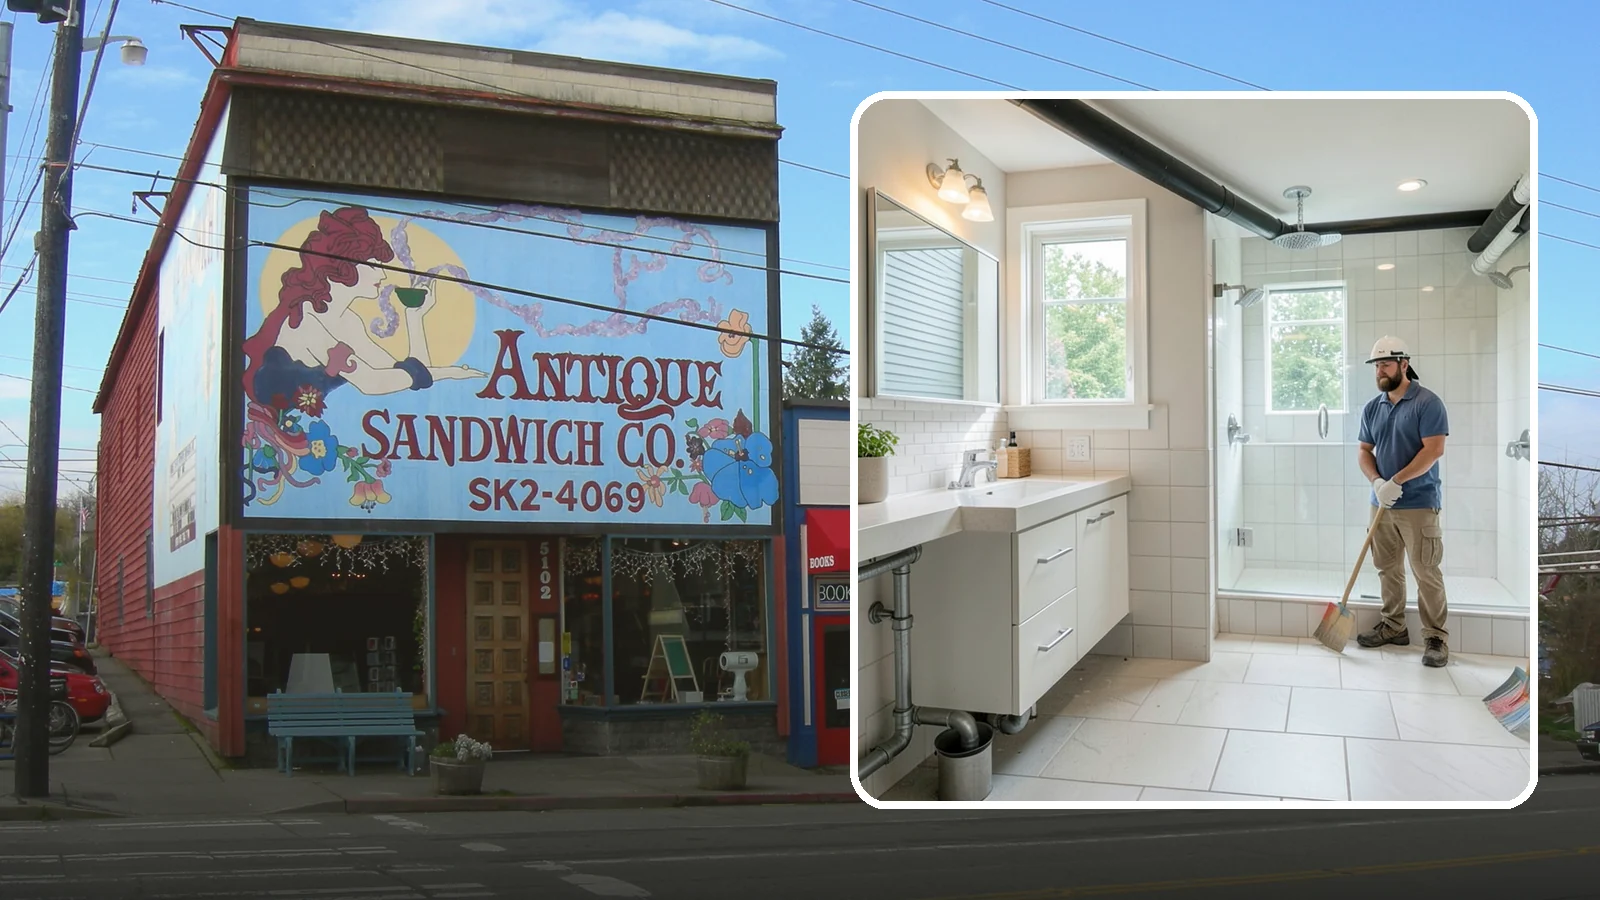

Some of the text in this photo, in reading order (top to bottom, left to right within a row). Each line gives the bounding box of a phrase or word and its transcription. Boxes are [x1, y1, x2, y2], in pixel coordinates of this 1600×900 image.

[475, 329, 723, 421] ANTIQUE
[361, 408, 685, 469] SANDWICH CO.
[468, 477, 646, 513] SK2-4069
[539, 542, 552, 599] 5102
[809, 555, 835, 569] BOOKS
